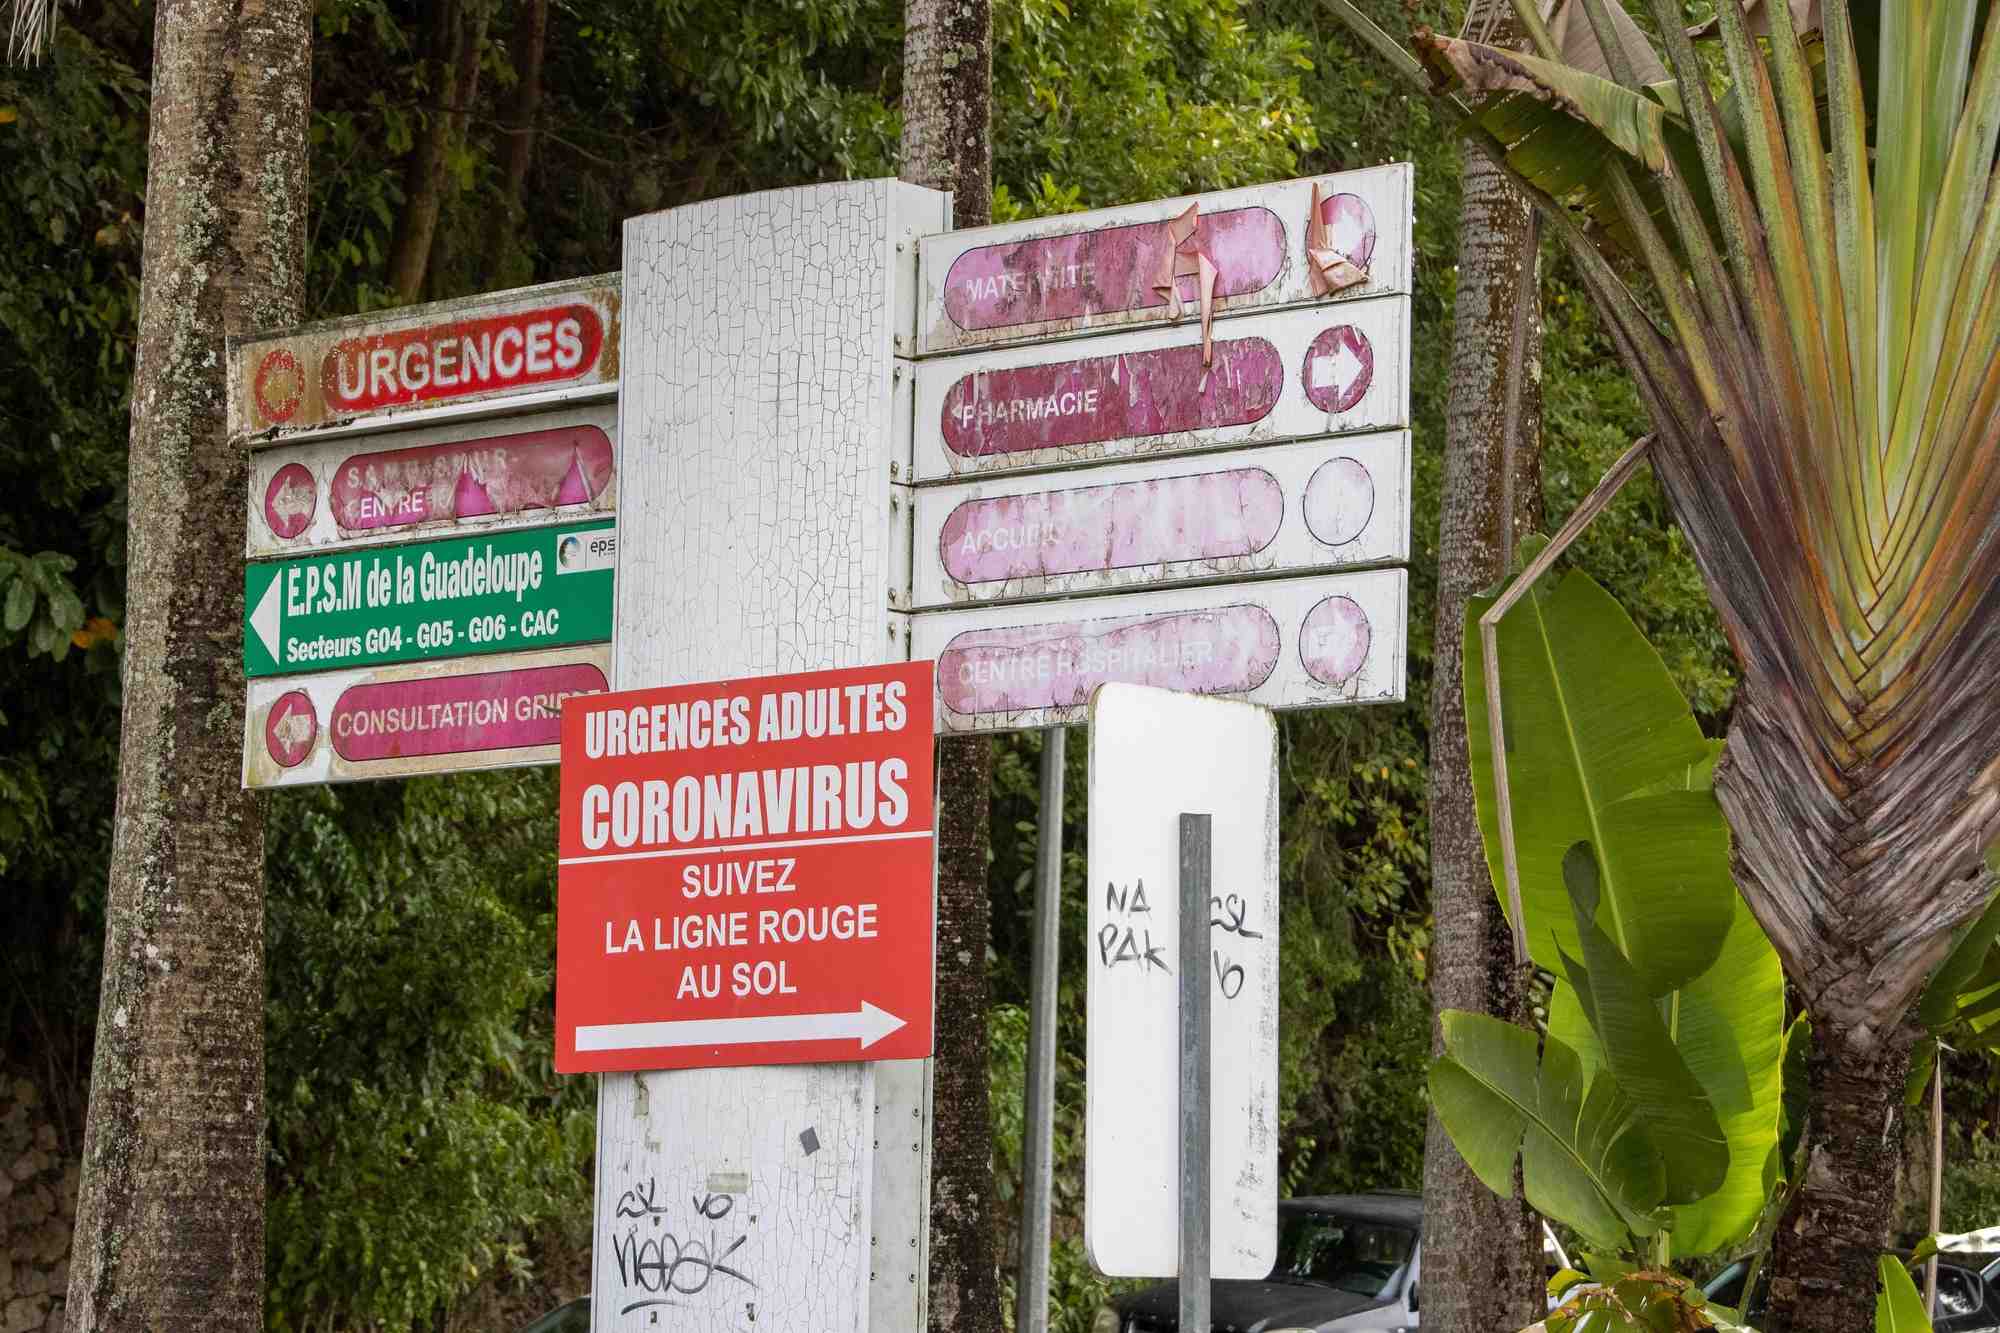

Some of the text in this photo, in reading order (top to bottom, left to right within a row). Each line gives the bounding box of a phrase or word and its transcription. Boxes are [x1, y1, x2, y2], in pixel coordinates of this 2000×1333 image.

[337, 318, 583, 400] URGENCES
[962, 389, 1098, 429] PHARMACIE
[366, 557, 392, 608] de
[396, 555, 415, 604] la
[420, 544, 543, 602] Guadeloupe
[287, 634, 361, 662] Secteurs
[365, 626, 402, 654] G04
[417, 620, 453, 648] G05
[468, 614, 506, 643] G06
[521, 608, 559, 637] CAC
[337, 697, 508, 737] CONSULTATION
[585, 680, 907, 759] URGENCES ADULTES
[581, 758, 909, 850] CORONAVIRUS
[681, 858, 796, 898] SUIVEZ
[605, 903, 879, 954] LA LIGNE ROUGE
[676, 960, 797, 999] AU SOL
